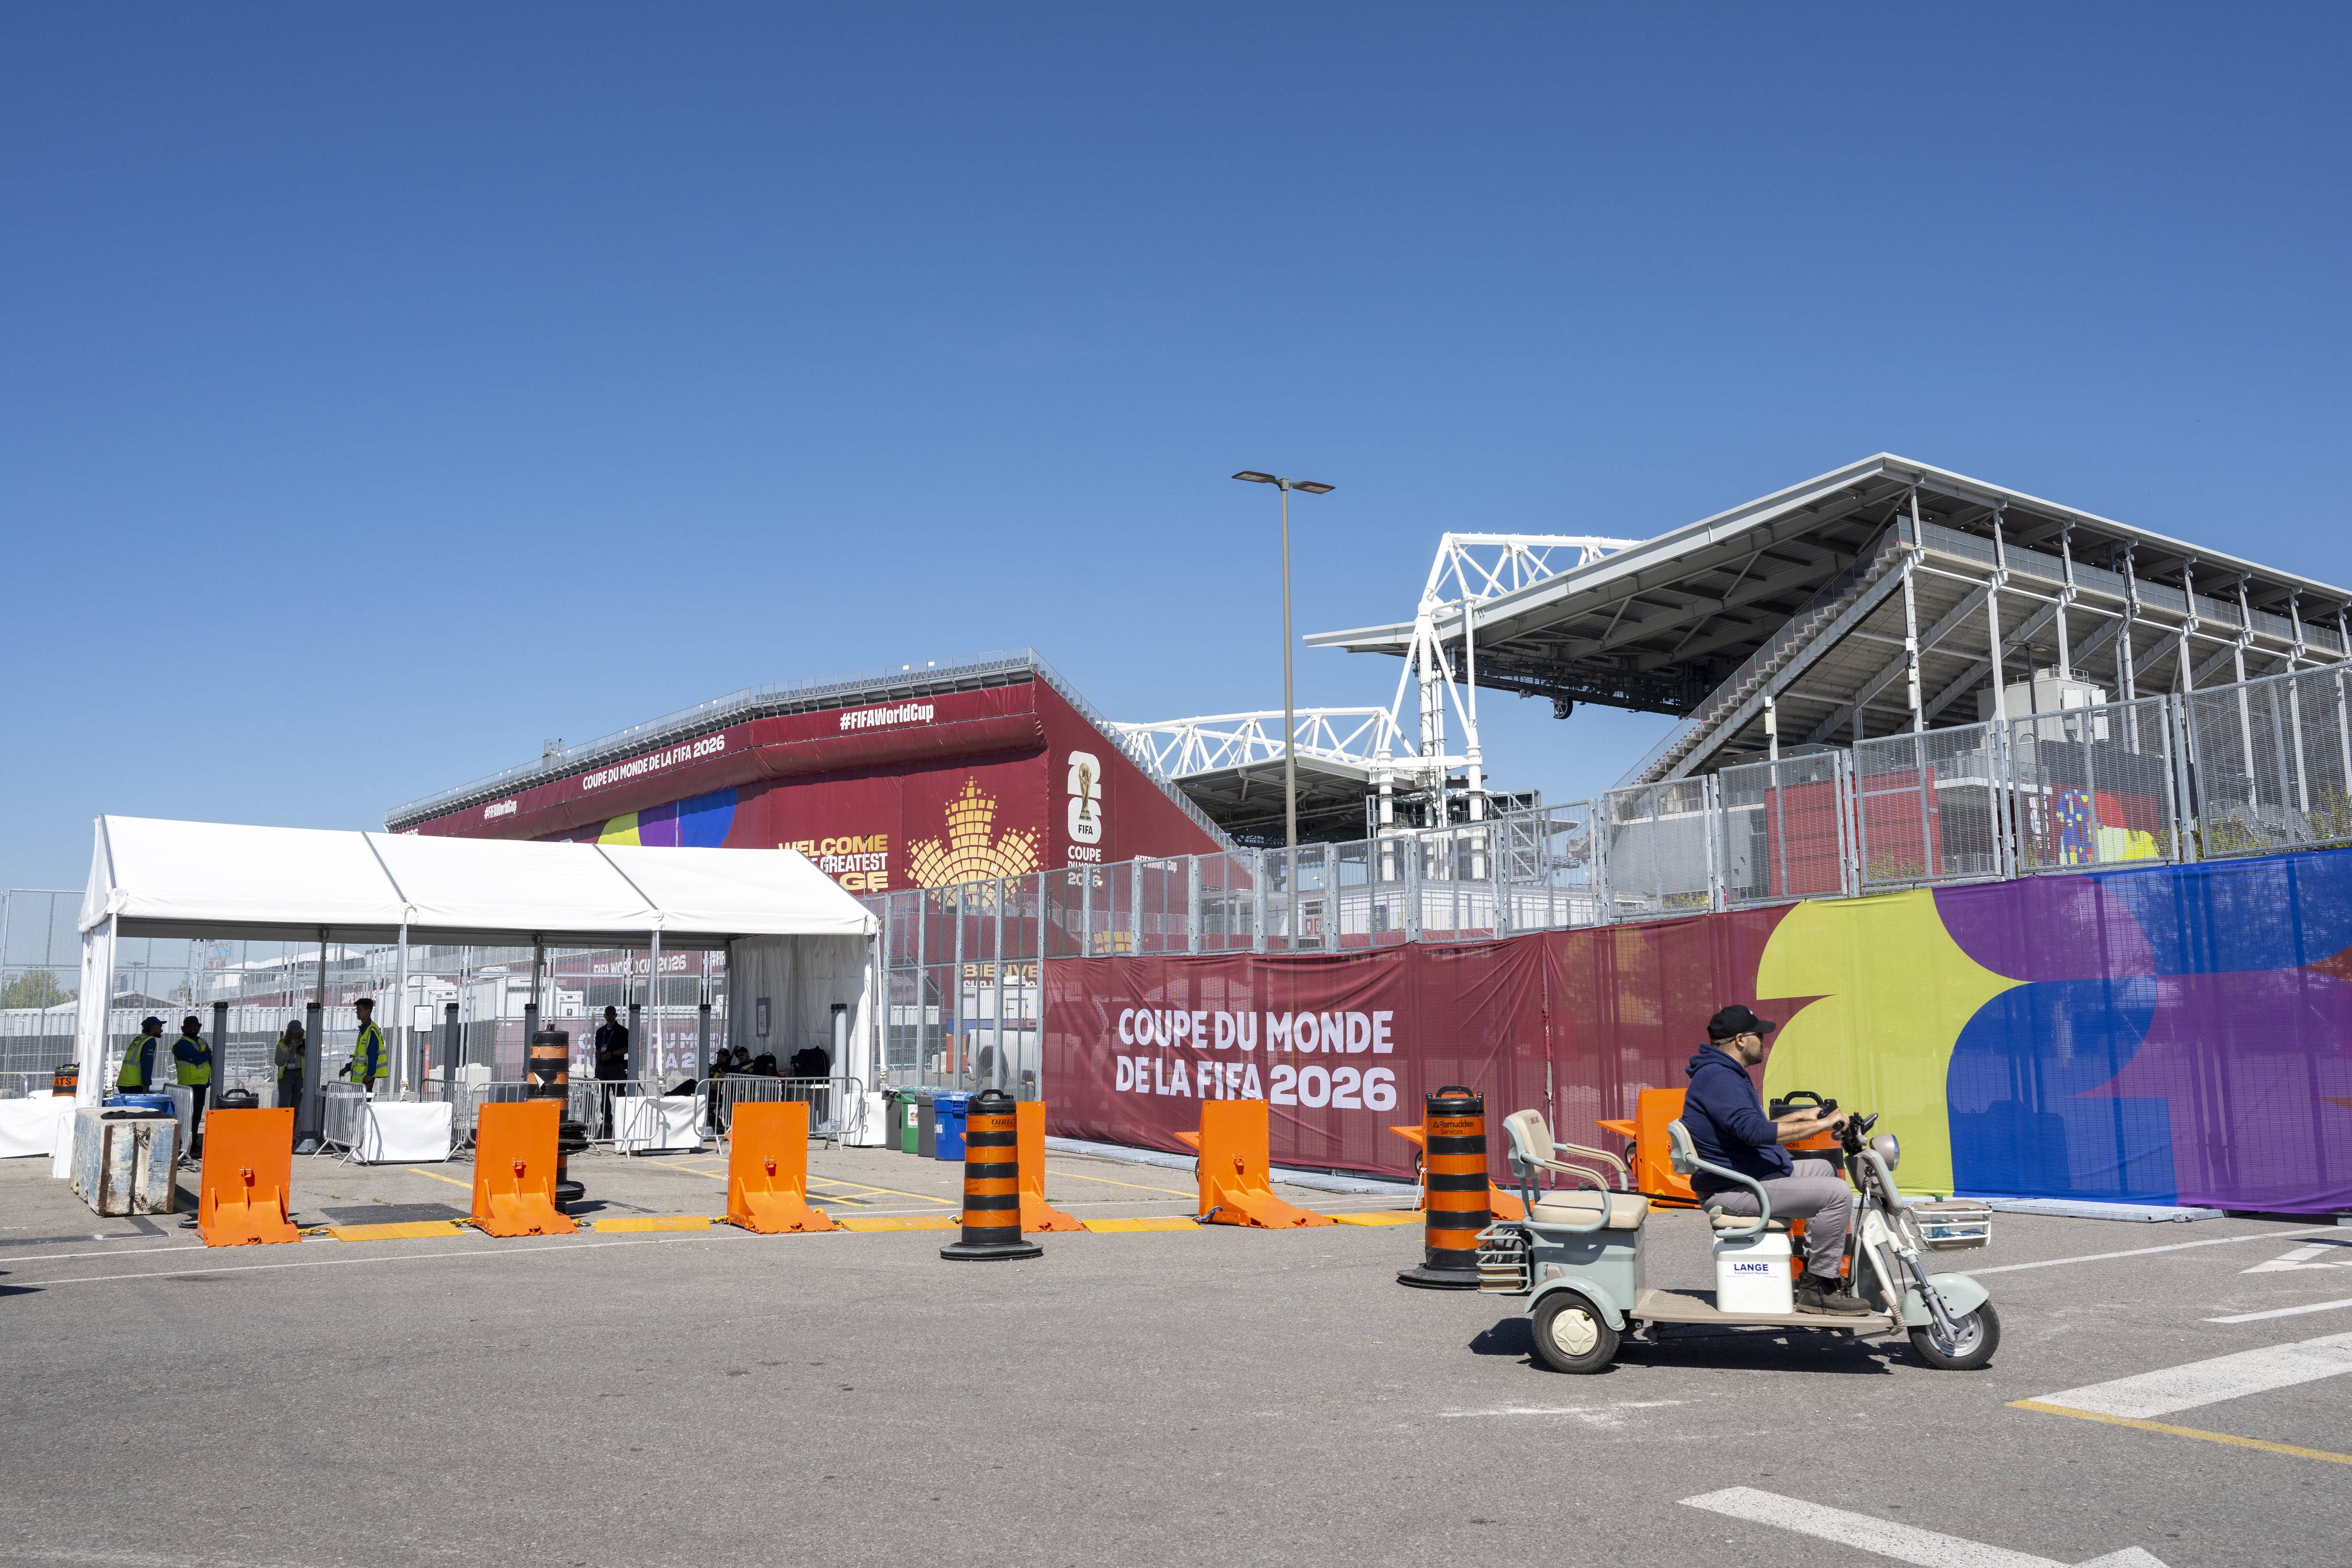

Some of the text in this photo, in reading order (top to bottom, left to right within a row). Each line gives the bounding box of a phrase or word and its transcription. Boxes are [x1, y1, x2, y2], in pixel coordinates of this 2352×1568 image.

[840, 704, 934, 730] #FIFAWorldCup
[583, 734, 725, 790] COUPE DU MONDE DE LA FIFA 2026
[484, 800, 517, 820] #FIFAWorldCup
[1078, 824, 1093, 835] FIFA
[820, 852, 887, 873] GREATEST
[1068, 845, 1101, 862] COUPE
[1134, 855, 1177, 873] #FIFAWorlCup
[839, 871, 888, 890] GE
[1067, 872, 1100, 887] 206
[639, 959, 651, 973] CU
[658, 954, 686, 972] 2026
[1119, 1008, 1394, 1053] COUPE DU MONDE
[1116, 1055, 1397, 1111] DE LA FIFA 2026
